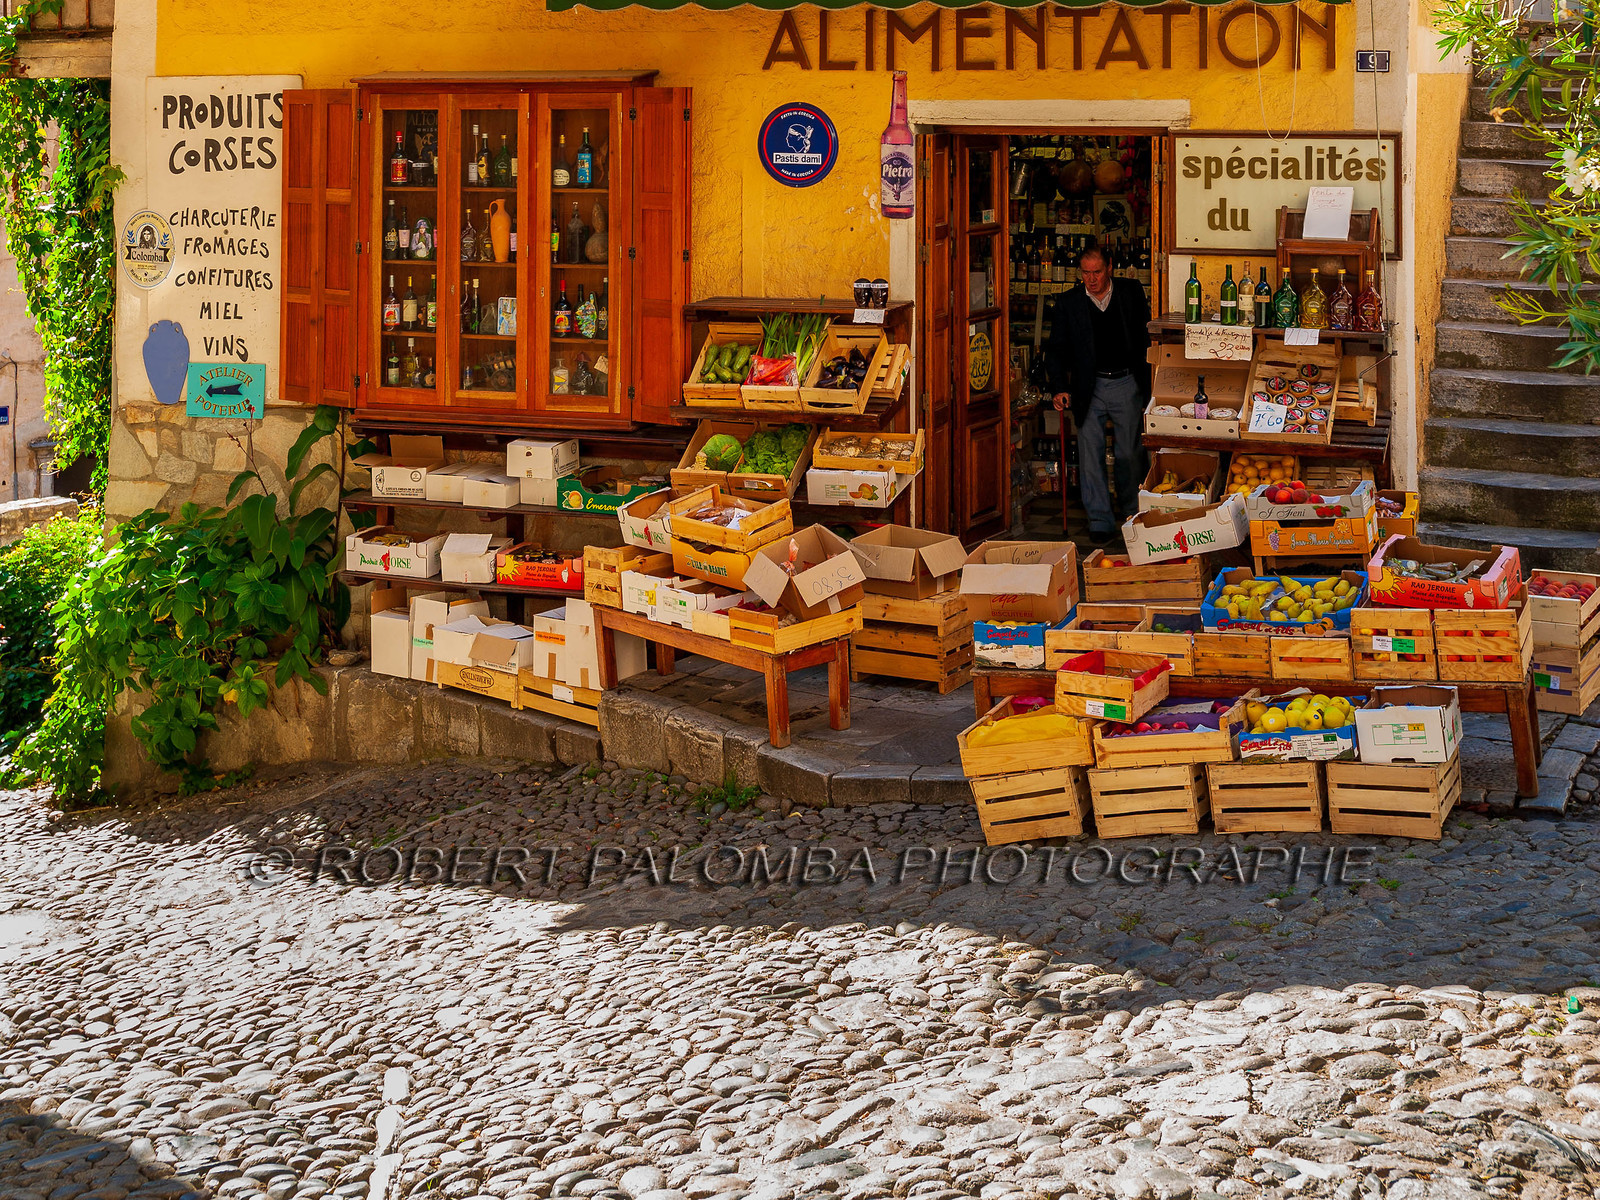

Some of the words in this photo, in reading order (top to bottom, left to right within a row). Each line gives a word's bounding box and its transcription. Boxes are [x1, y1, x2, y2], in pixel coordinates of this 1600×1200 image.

[761, 4, 1336, 71] ALIMENTATION
[1368, 54, 1377, 69] 9
[162, 92, 283, 130] PRODUITS
[168, 136, 277, 174] CORSES
[775, 154, 799, 163] Pastis
[801, 155, 821, 163] dami
[882, 163, 913, 178] Pietra
[1182, 146, 1387, 189] spécialités
[169, 206, 277, 230] CHARCUTERIE
[1207, 197, 1251, 231] du
[131, 249, 163, 264] Colomba
[183, 236, 270, 258] FROMAGES
[174, 266, 274, 291] CONFITURES
[199, 301, 243, 320] MIEL
[203, 334, 249, 362] VINS
[1208, 341, 1234, 360] 23
[200, 366, 254, 388] ATELIER
[195, 394, 252, 416] POTERIE
[1145, 541, 1172, 557] Produit
[1180, 529, 1216, 548] CORSE
[359, 552, 379, 567] Produit
[384, 556, 412, 570] CORSE
[1411, 581, 1426, 589] RAO
[1427, 584, 1457, 594] JEROME
[986, 629, 1012, 640] Samuel
[1216, 618, 1263, 632] Samuel
[1240, 736, 1273, 752] Samuel
